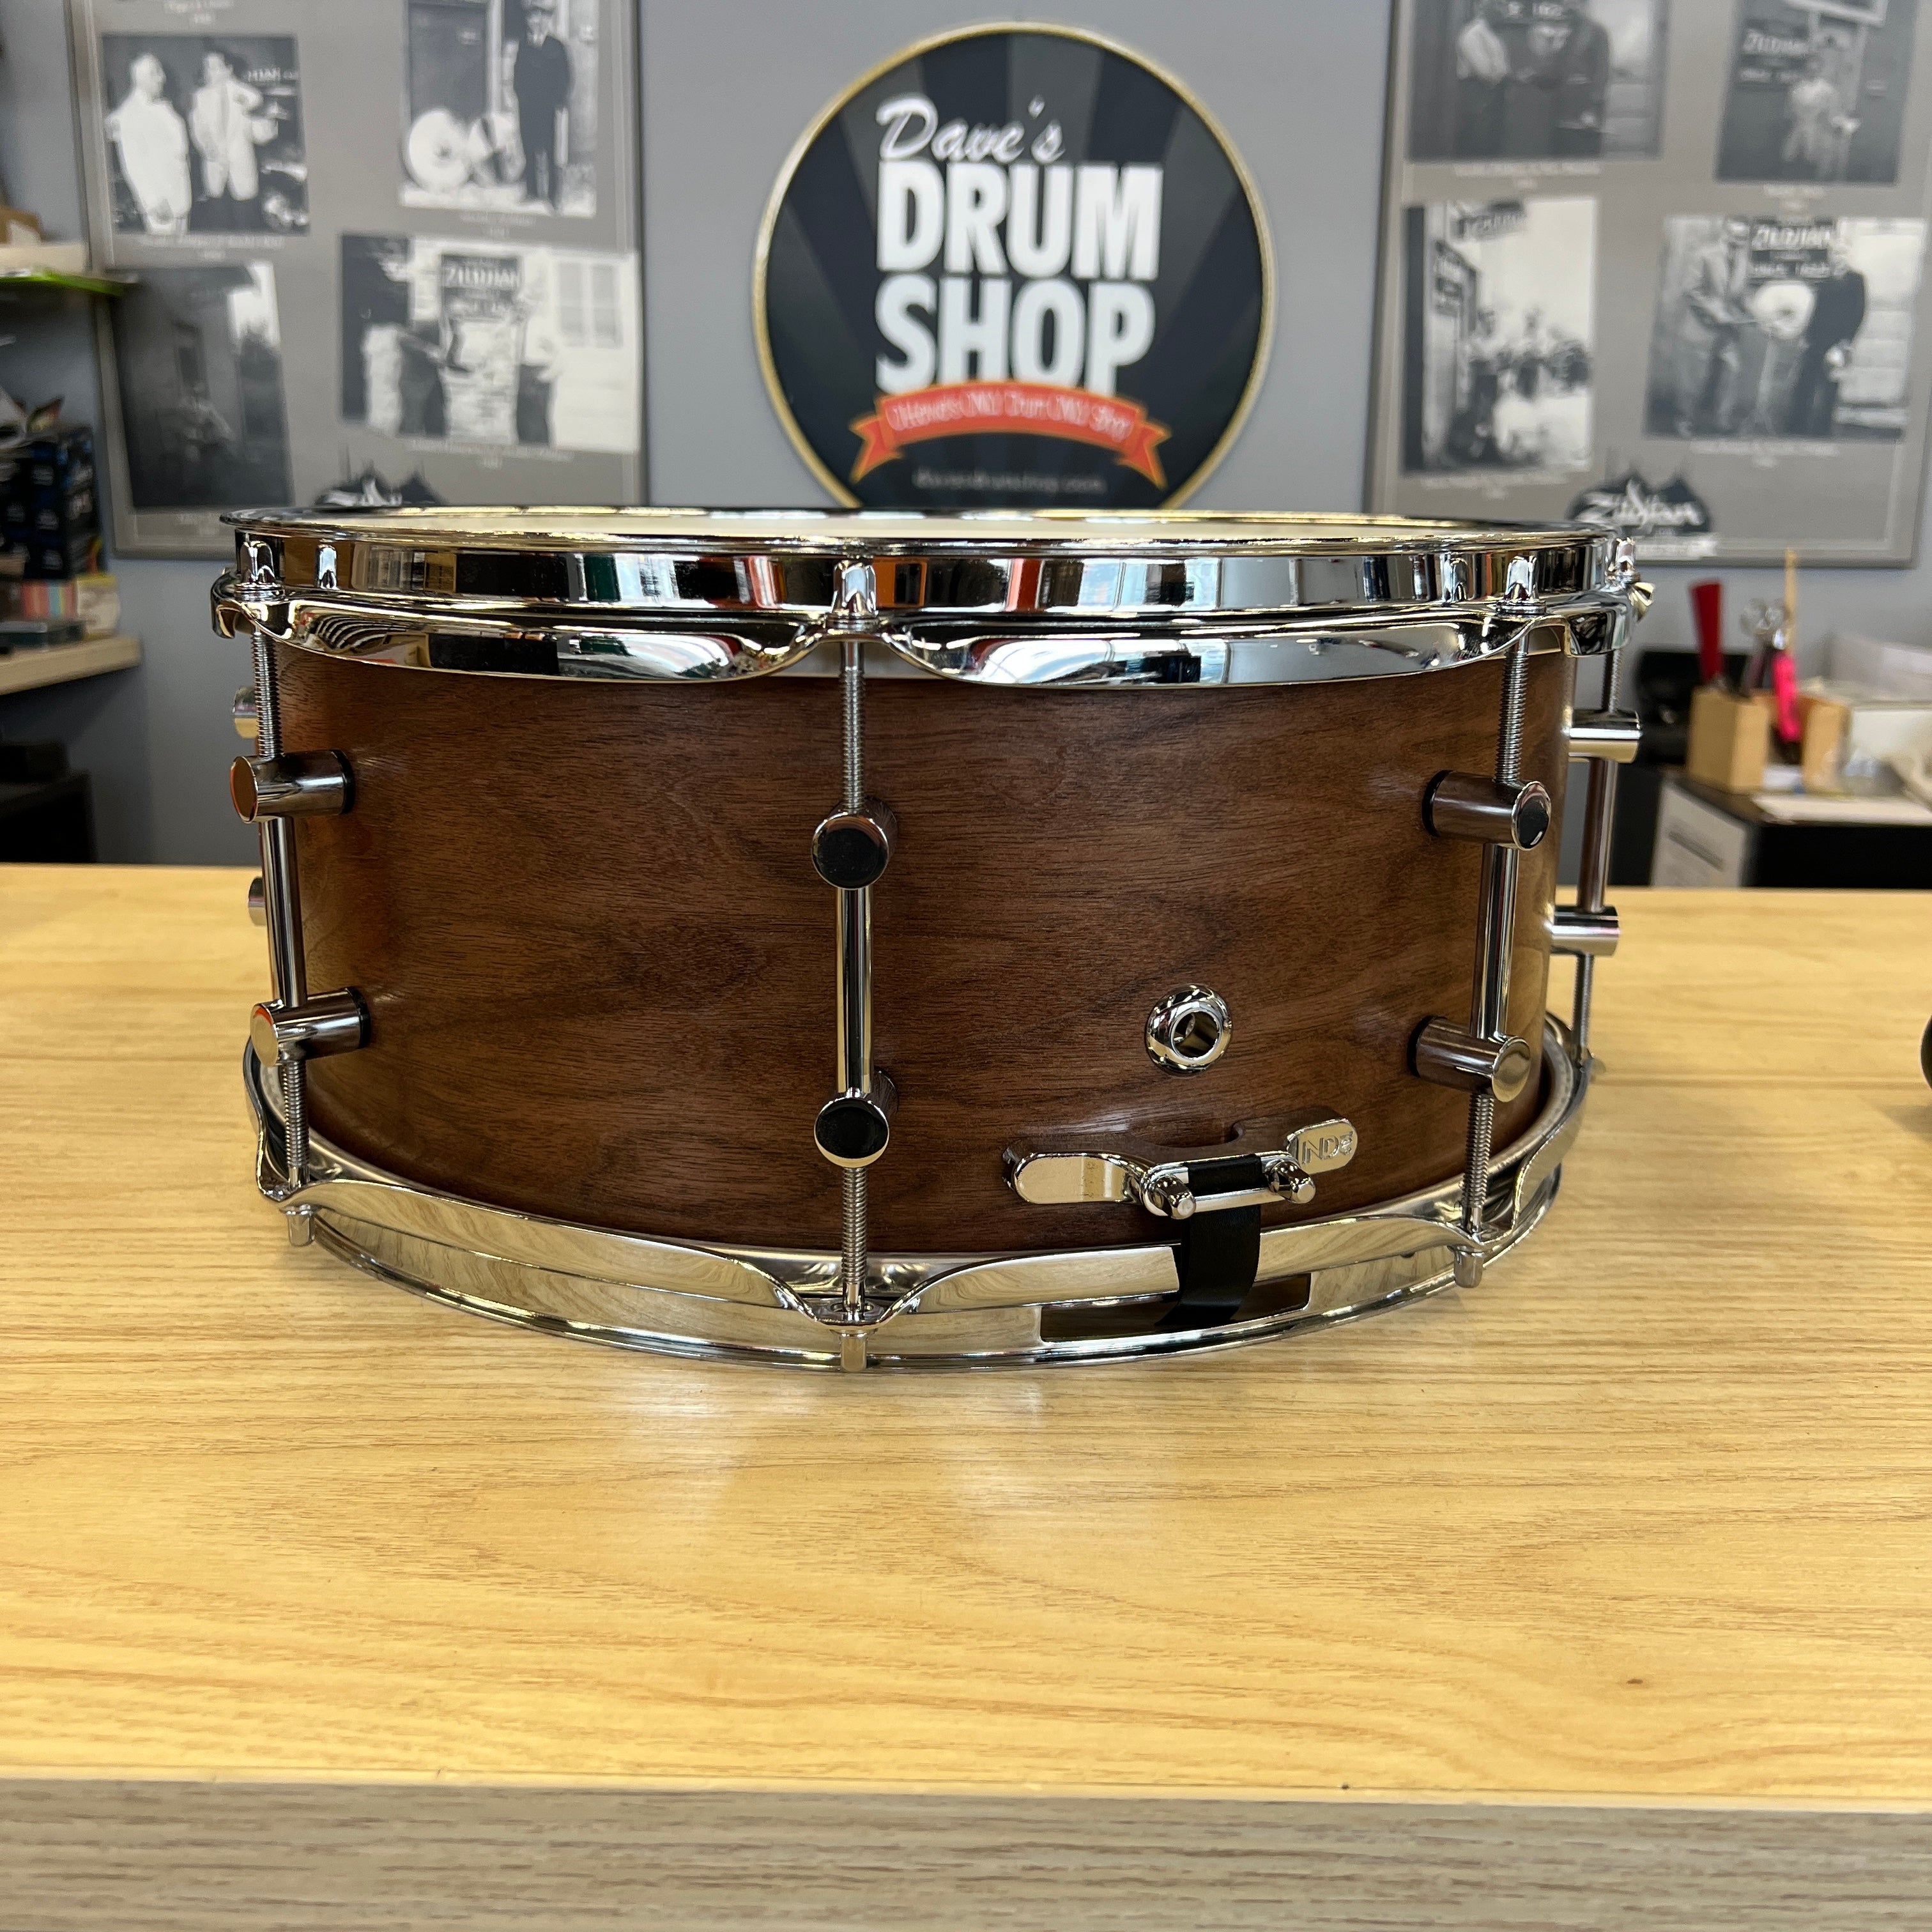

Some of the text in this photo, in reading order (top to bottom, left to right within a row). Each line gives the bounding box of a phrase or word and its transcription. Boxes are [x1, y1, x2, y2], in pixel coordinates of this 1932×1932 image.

[875, 95, 1066, 164] Dave's
[877, 159, 1164, 281] DRUM
[875, 273, 1155, 397] SHOP
